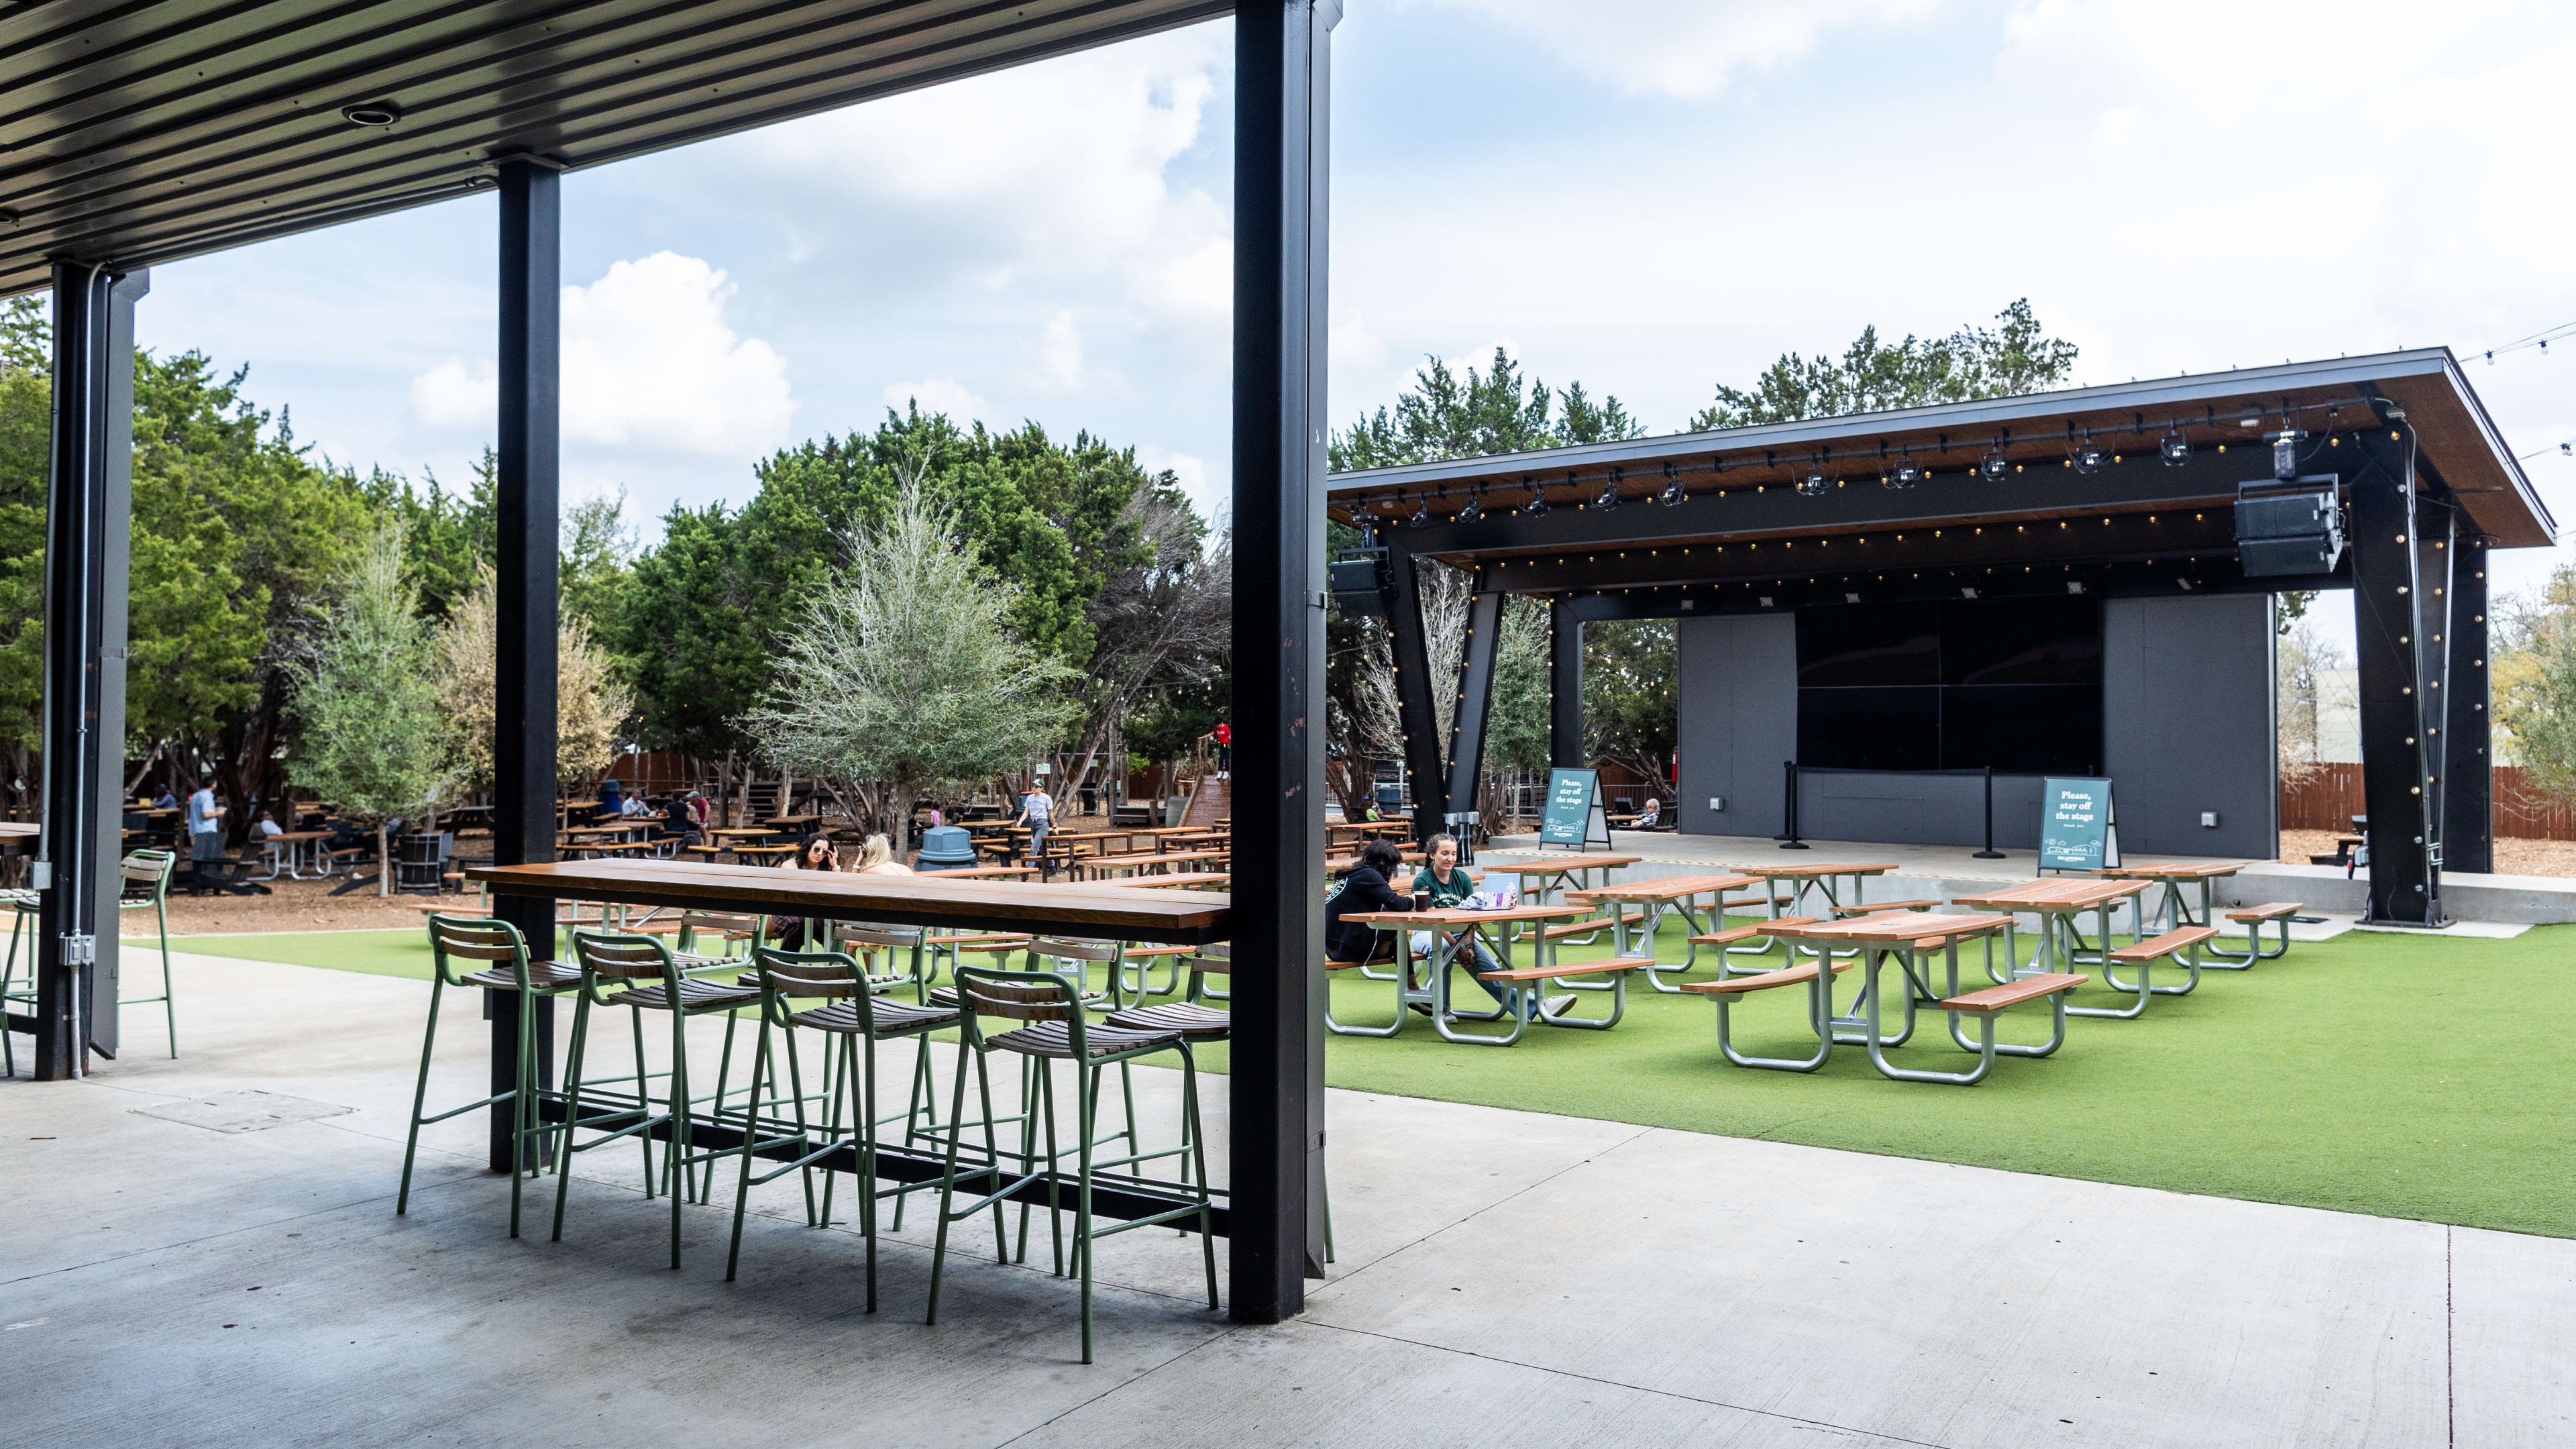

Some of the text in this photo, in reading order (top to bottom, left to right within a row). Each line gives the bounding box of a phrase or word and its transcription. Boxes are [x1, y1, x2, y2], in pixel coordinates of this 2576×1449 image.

[1561, 779, 1582, 788] Please,
[2061, 791, 2092, 801] Please,
[1566, 797, 1582, 805] stage
[2060, 801, 2092, 810] stay off
[2055, 812, 2094, 822] the stage
